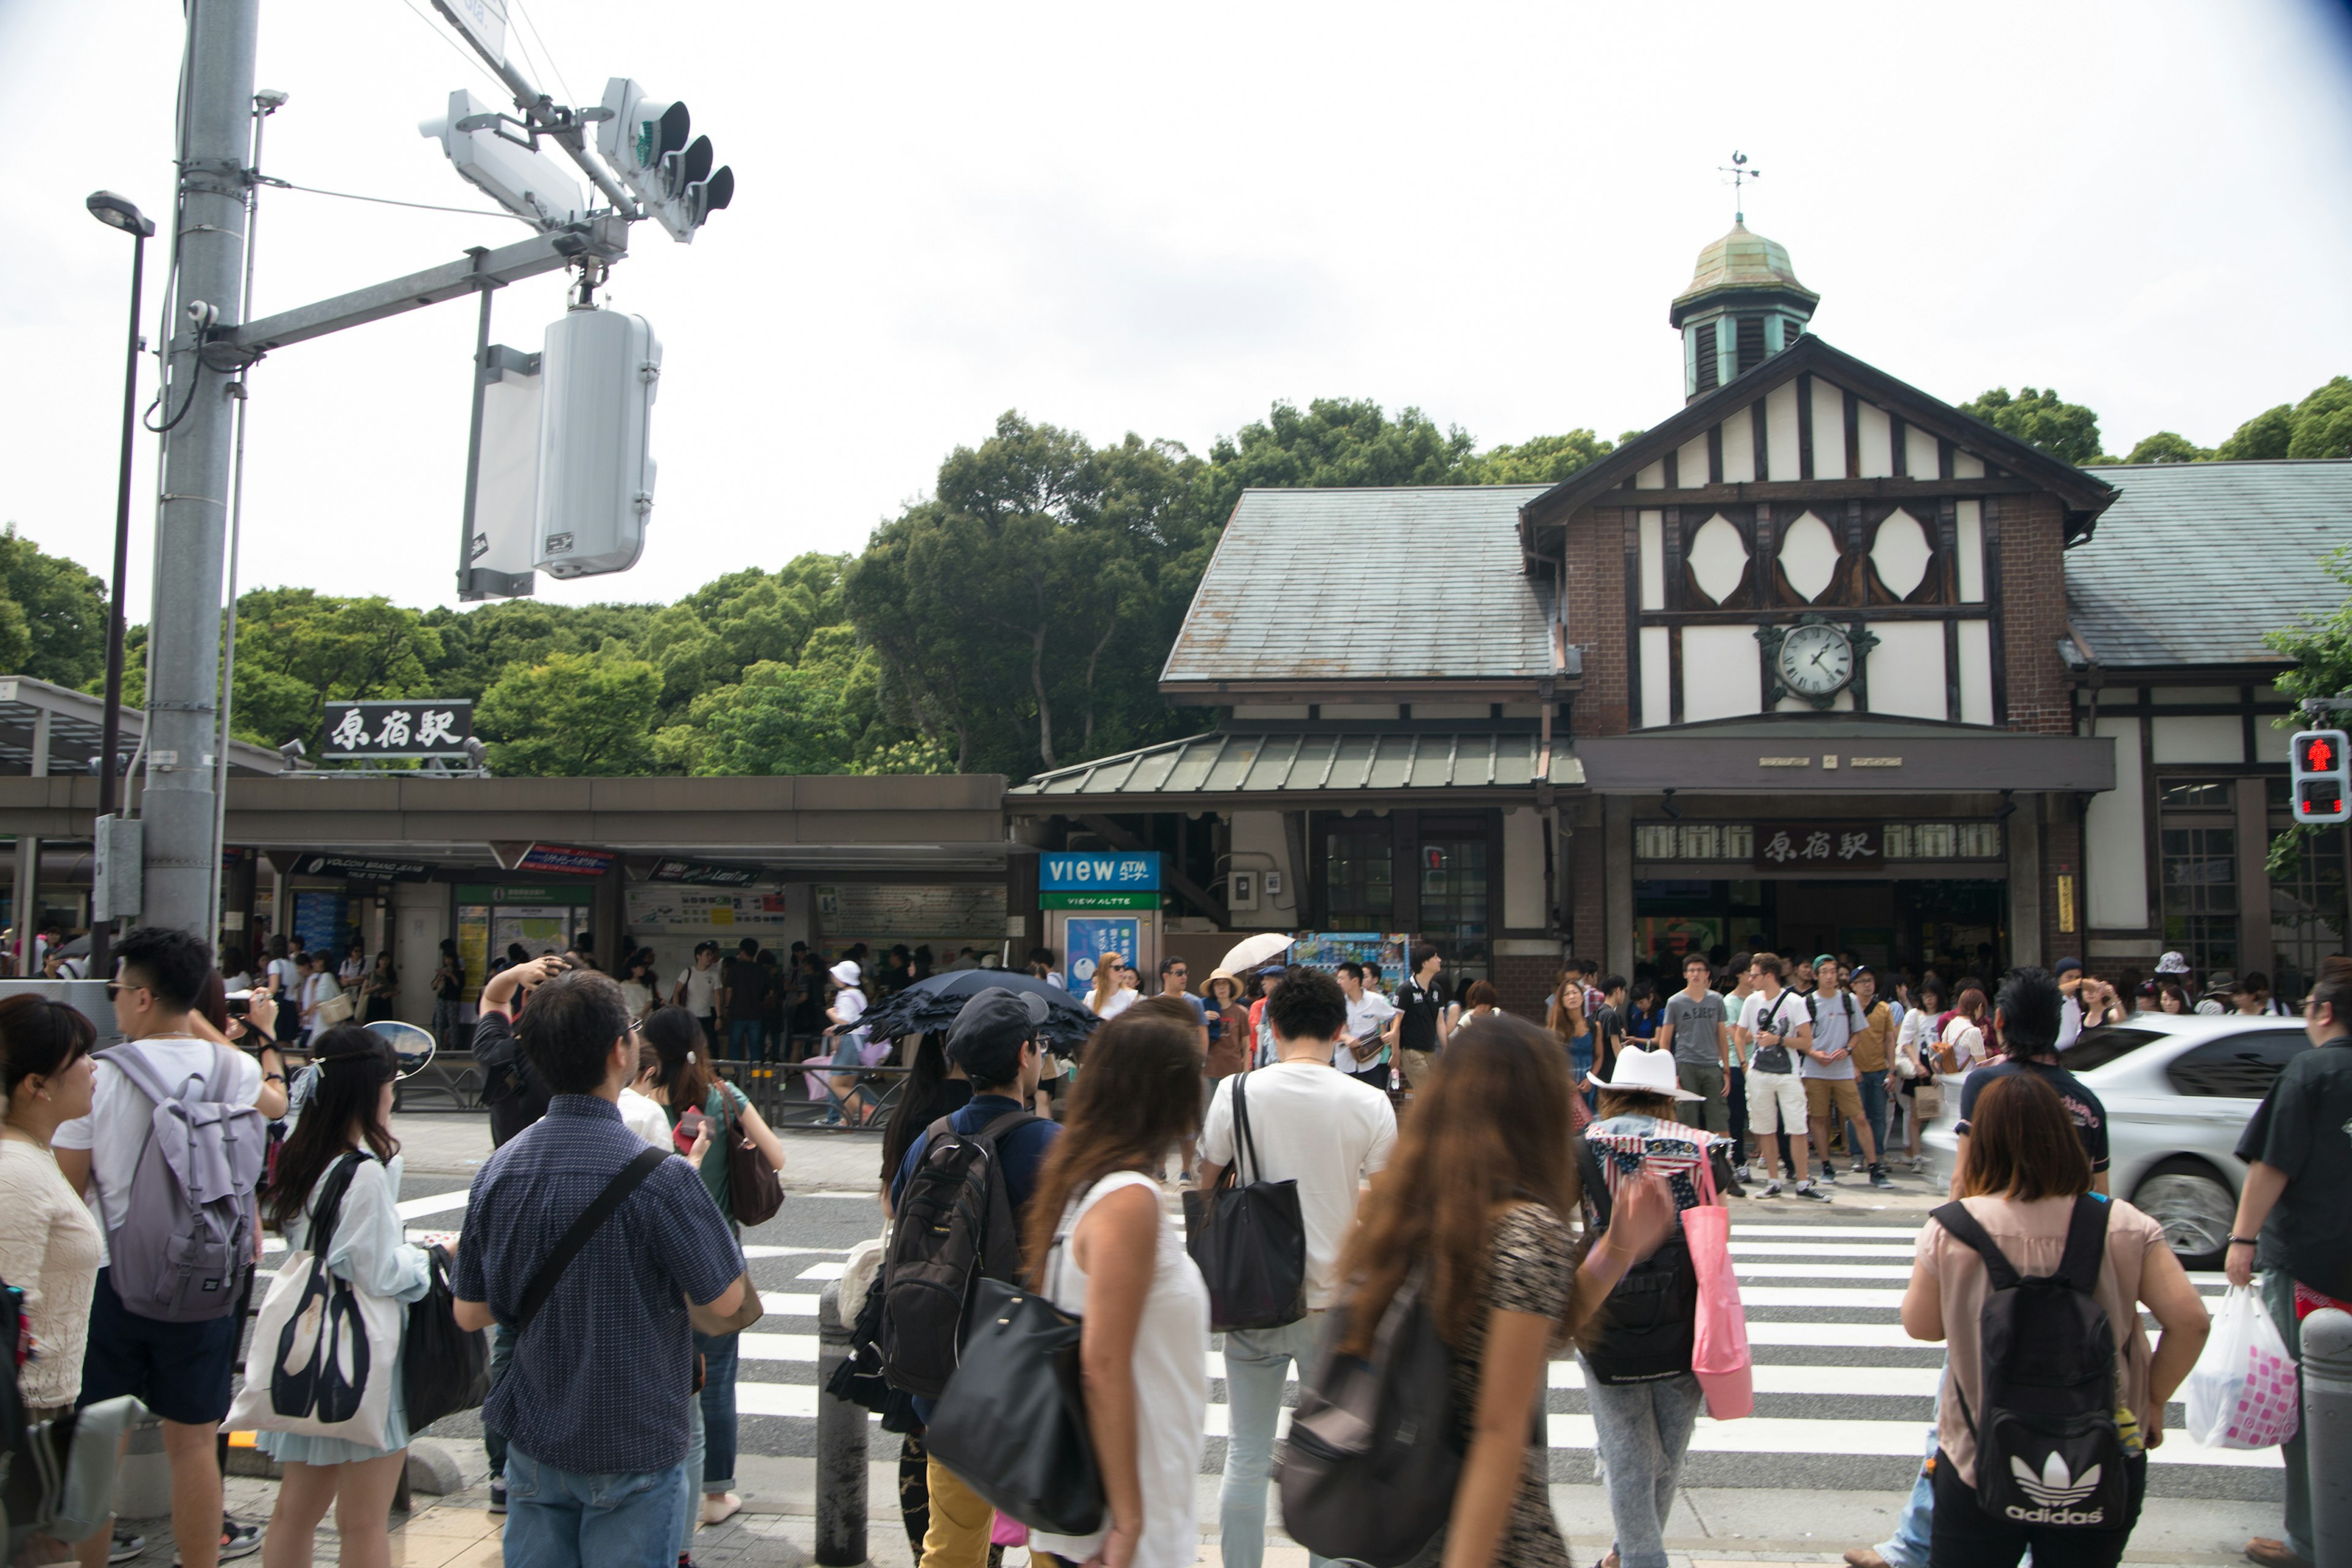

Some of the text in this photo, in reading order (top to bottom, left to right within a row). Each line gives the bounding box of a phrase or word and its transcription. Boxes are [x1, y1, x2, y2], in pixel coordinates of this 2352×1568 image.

[331, 707, 462, 750] 原宿駅
[1763, 831, 1877, 863] 原宿駅
[326, 858, 364, 869] VOLCOM
[365, 862, 396, 870] BRAND
[1120, 861, 1147, 872] ATM
[1119, 872, 1149, 881] コーナー
[2005, 1505, 2104, 1525] adidas
